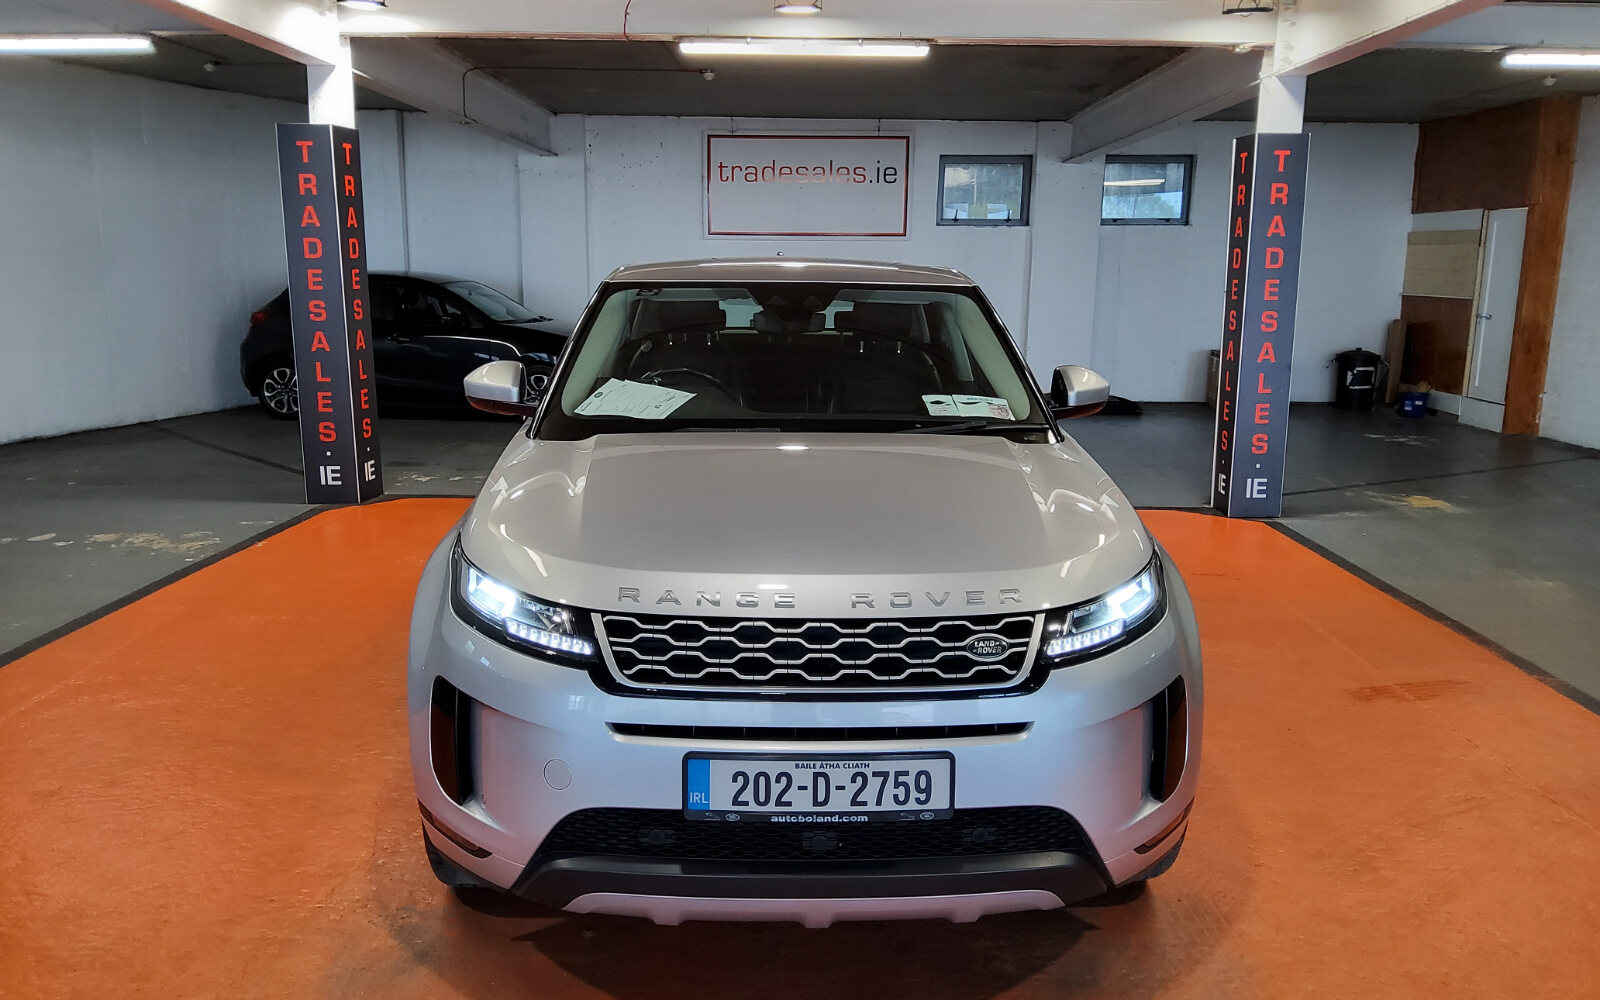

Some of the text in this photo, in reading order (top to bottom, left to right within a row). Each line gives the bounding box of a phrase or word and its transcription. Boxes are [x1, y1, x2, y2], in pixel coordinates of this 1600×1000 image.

[717, 159, 898, 184] tradesales.ie
[617, 586, 1022, 609] RANGE ROVER
[794, 762, 818, 770] BAILE
[819, 761, 841, 770] ÁTHA
[731, 770, 932, 807] 202-D-2759
[689, 792, 709, 804] IRL
[770, 814, 869, 823] autoboland.com
